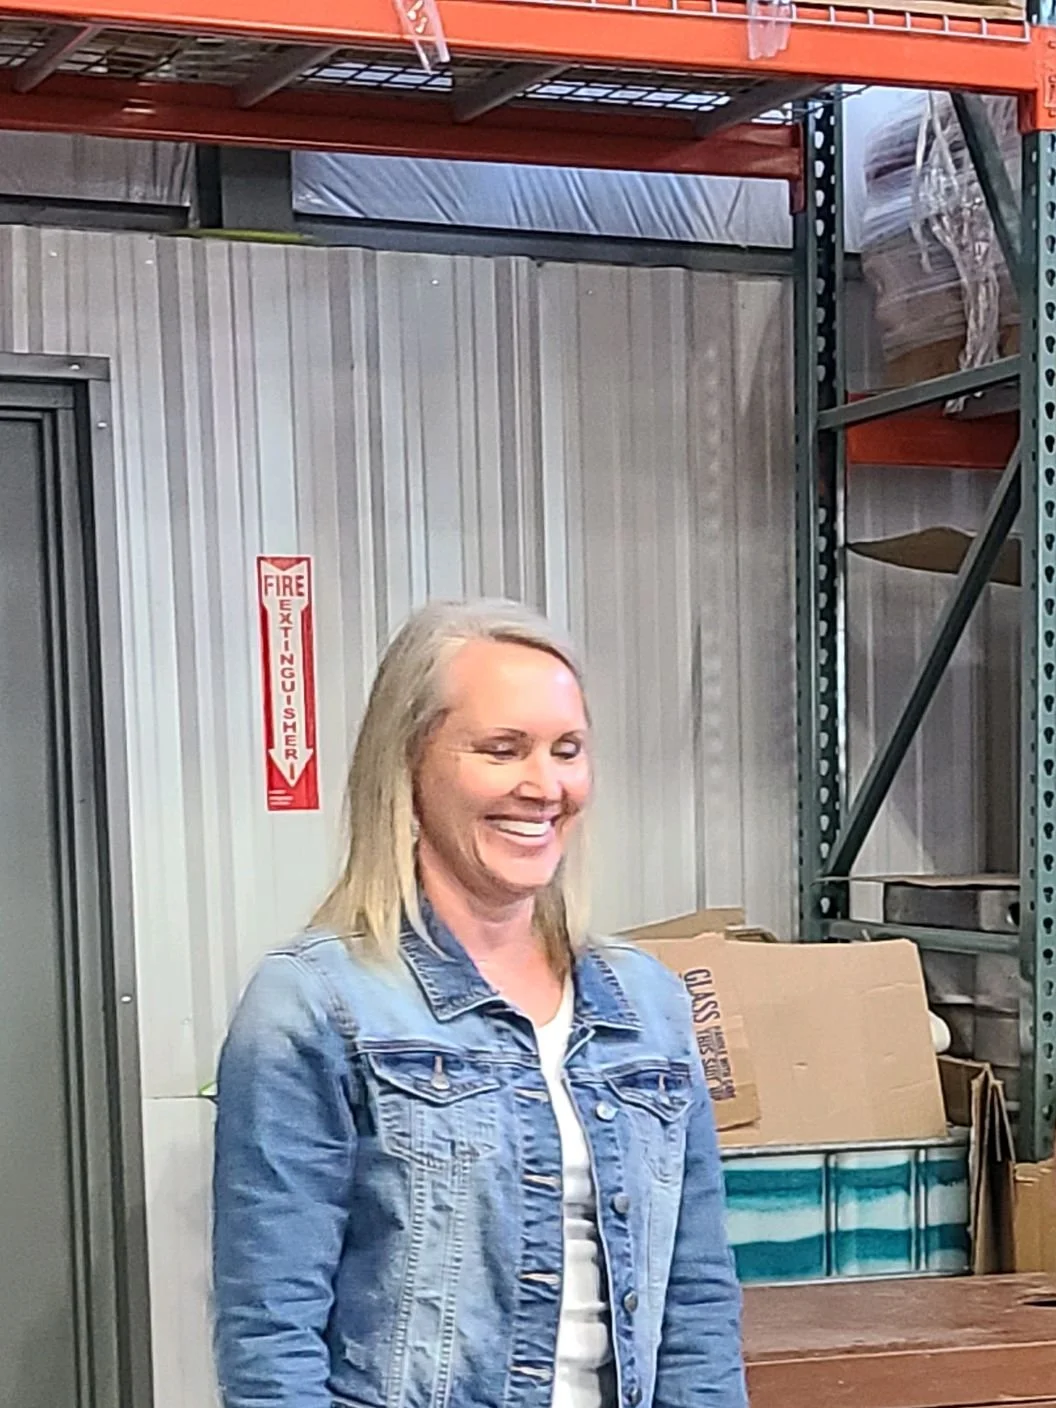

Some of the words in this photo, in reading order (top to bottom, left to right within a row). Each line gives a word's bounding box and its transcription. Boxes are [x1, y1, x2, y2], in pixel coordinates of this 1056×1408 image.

[263, 574, 305, 597] FIRE
[278, 599, 298, 760] EXTINGUISHER
[683, 968, 721, 1024] GLASS
